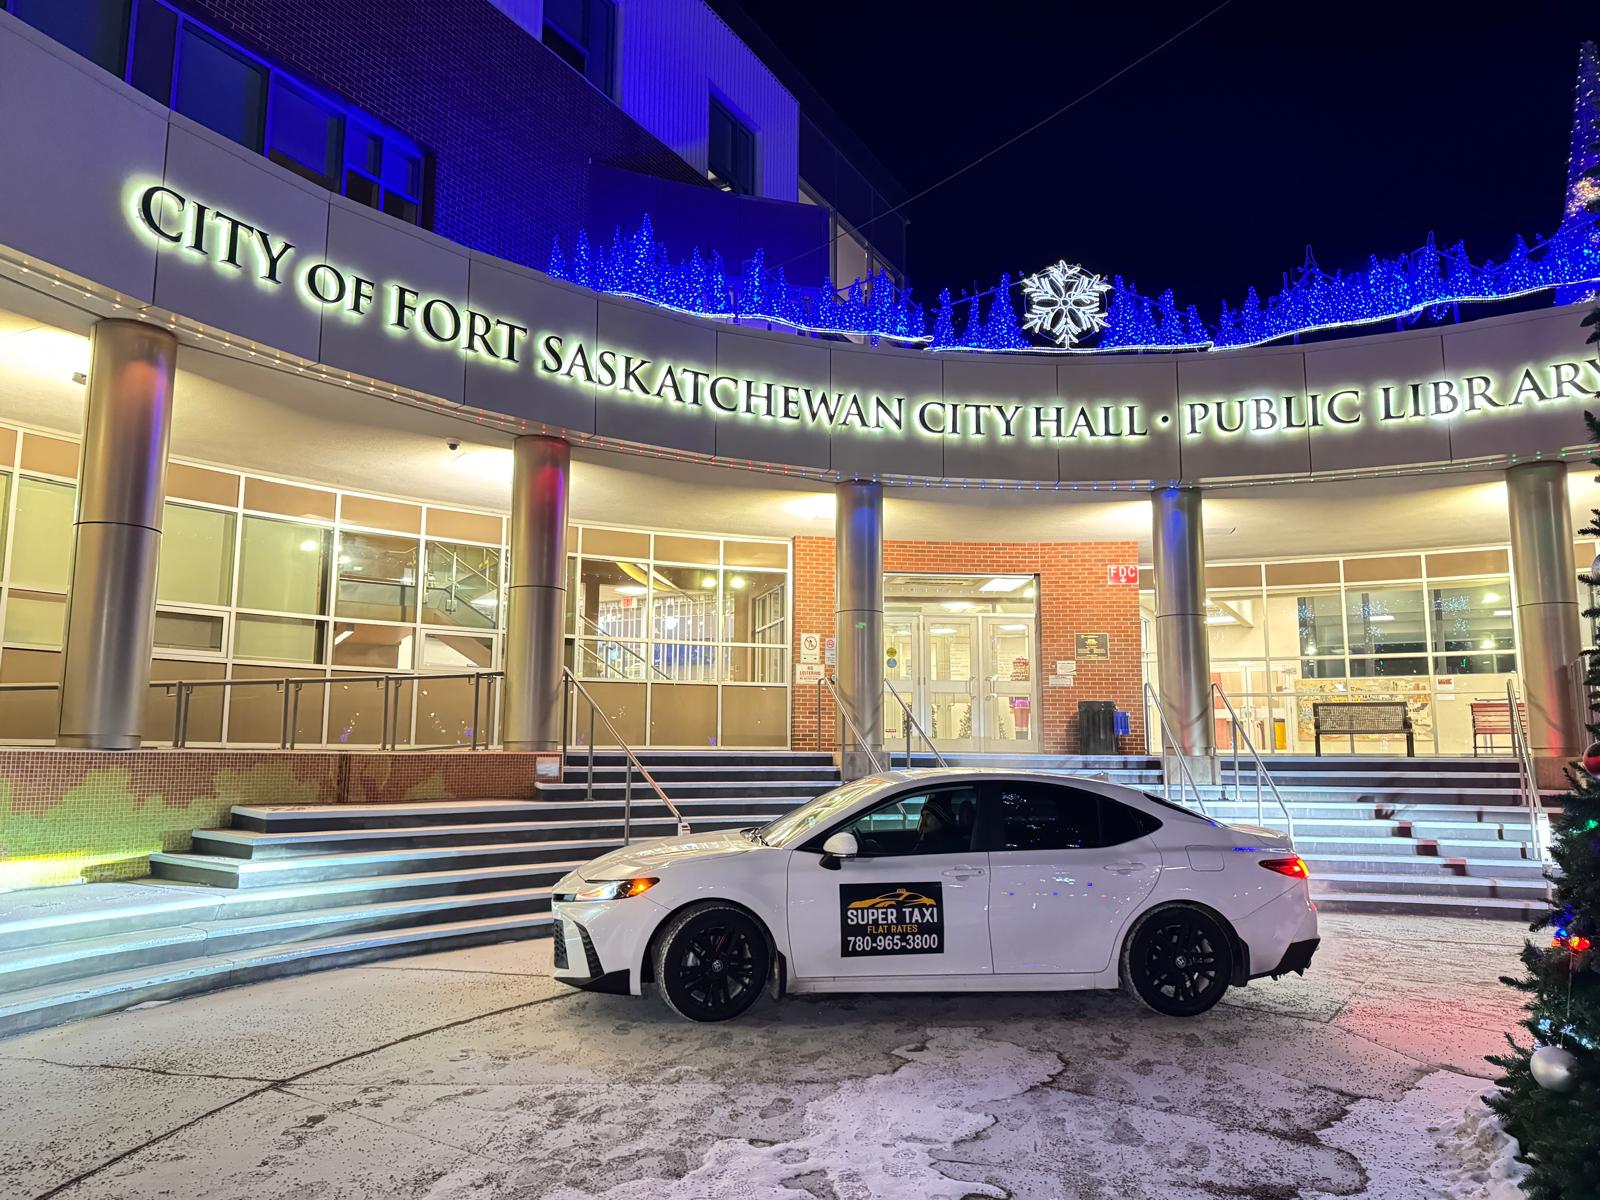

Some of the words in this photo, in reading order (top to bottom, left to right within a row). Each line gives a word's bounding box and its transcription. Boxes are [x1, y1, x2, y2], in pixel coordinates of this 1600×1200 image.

[140, 185, 296, 285] CITY
[306, 263, 375, 315] OF
[390, 283, 528, 364] FORT
[541, 335, 905, 431] SASKATCHEWAN
[918, 401, 1023, 437] CITY
[1031, 404, 1148, 438] HALL
[1185, 389, 1361, 435] PUBLIC
[1110, 565, 1136, 578] FDC
[847, 908, 897, 925] SUPER
[902, 907, 938, 923] TAXI
[867, 925, 888, 934] FLAT
[891, 924, 918, 933] RATES
[847, 934, 938, 951] 780-965-3800
